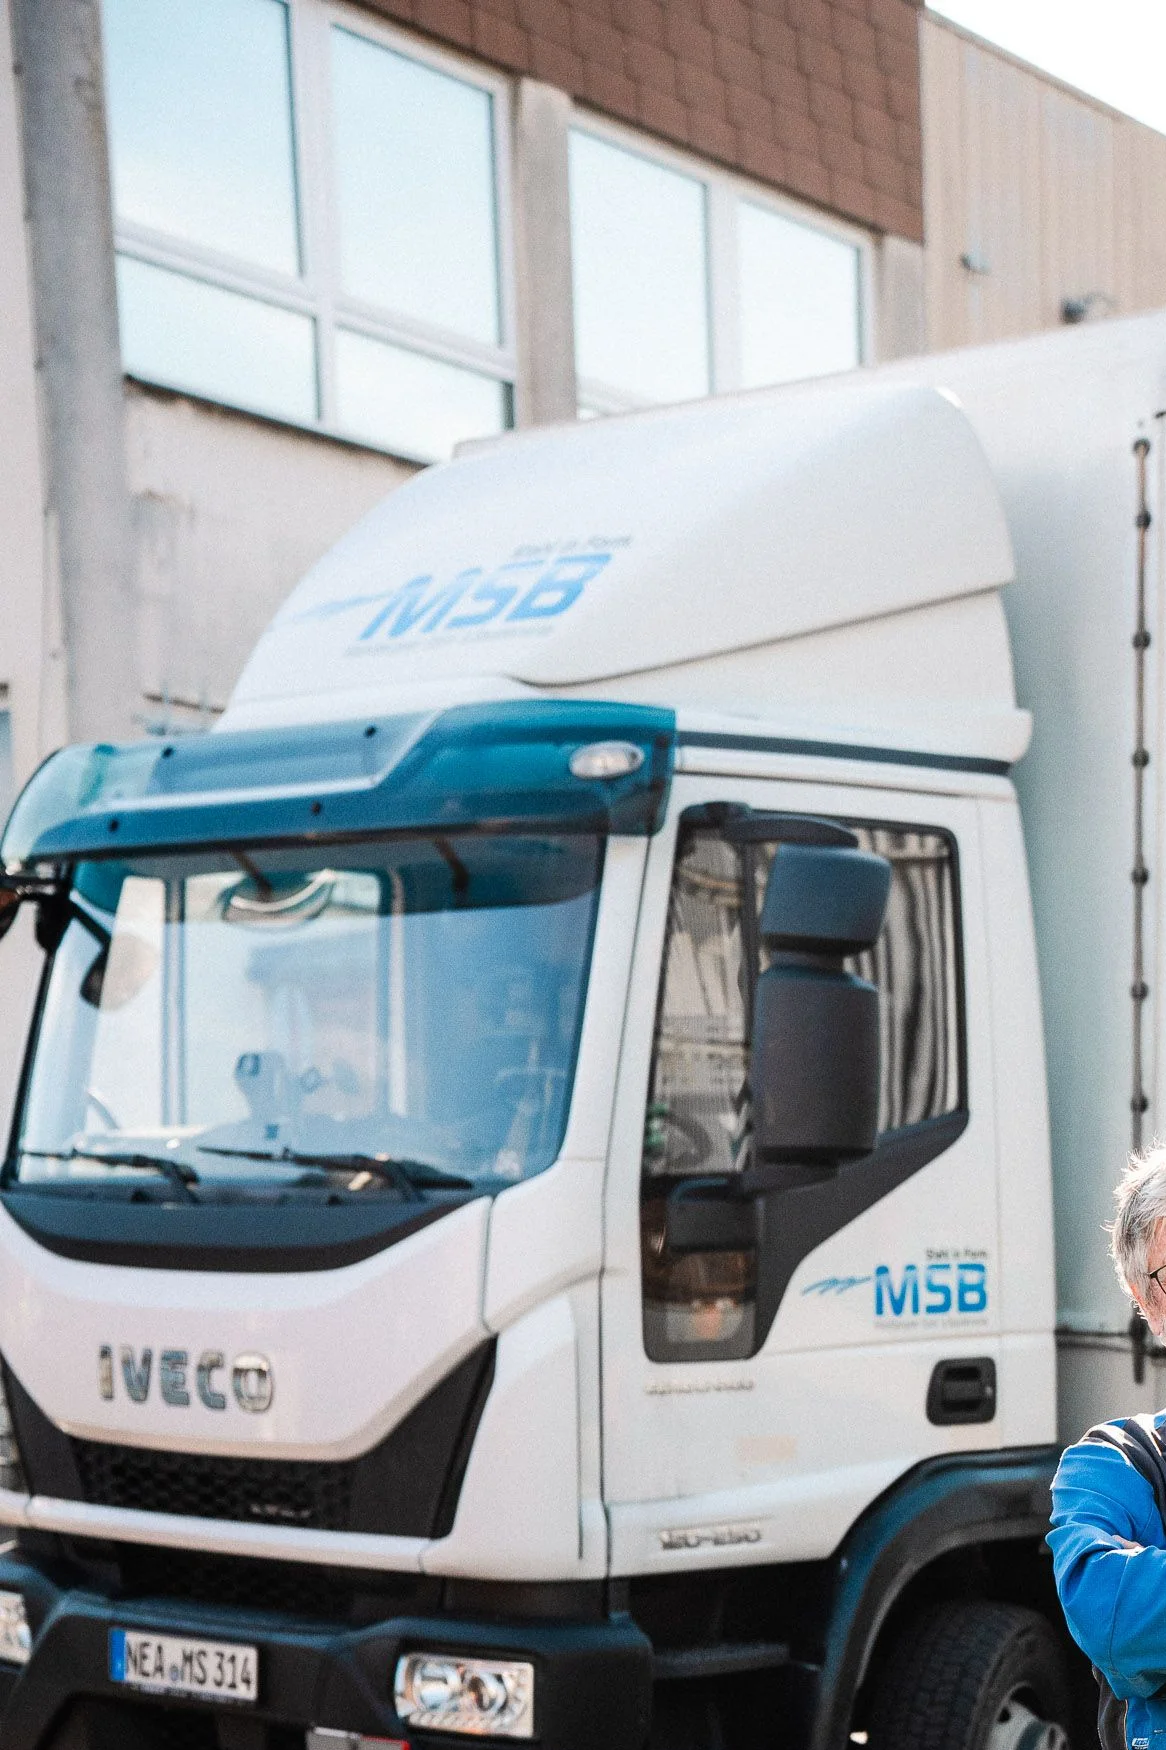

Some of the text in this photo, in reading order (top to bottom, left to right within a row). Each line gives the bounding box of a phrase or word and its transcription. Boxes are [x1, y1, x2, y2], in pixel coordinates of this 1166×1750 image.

[360, 553, 614, 640] MSB
[875, 1263, 988, 1316] MSB
[98, 1345, 275, 1413] IVECO
[126, 1639, 251, 1690] NEA MS 314
